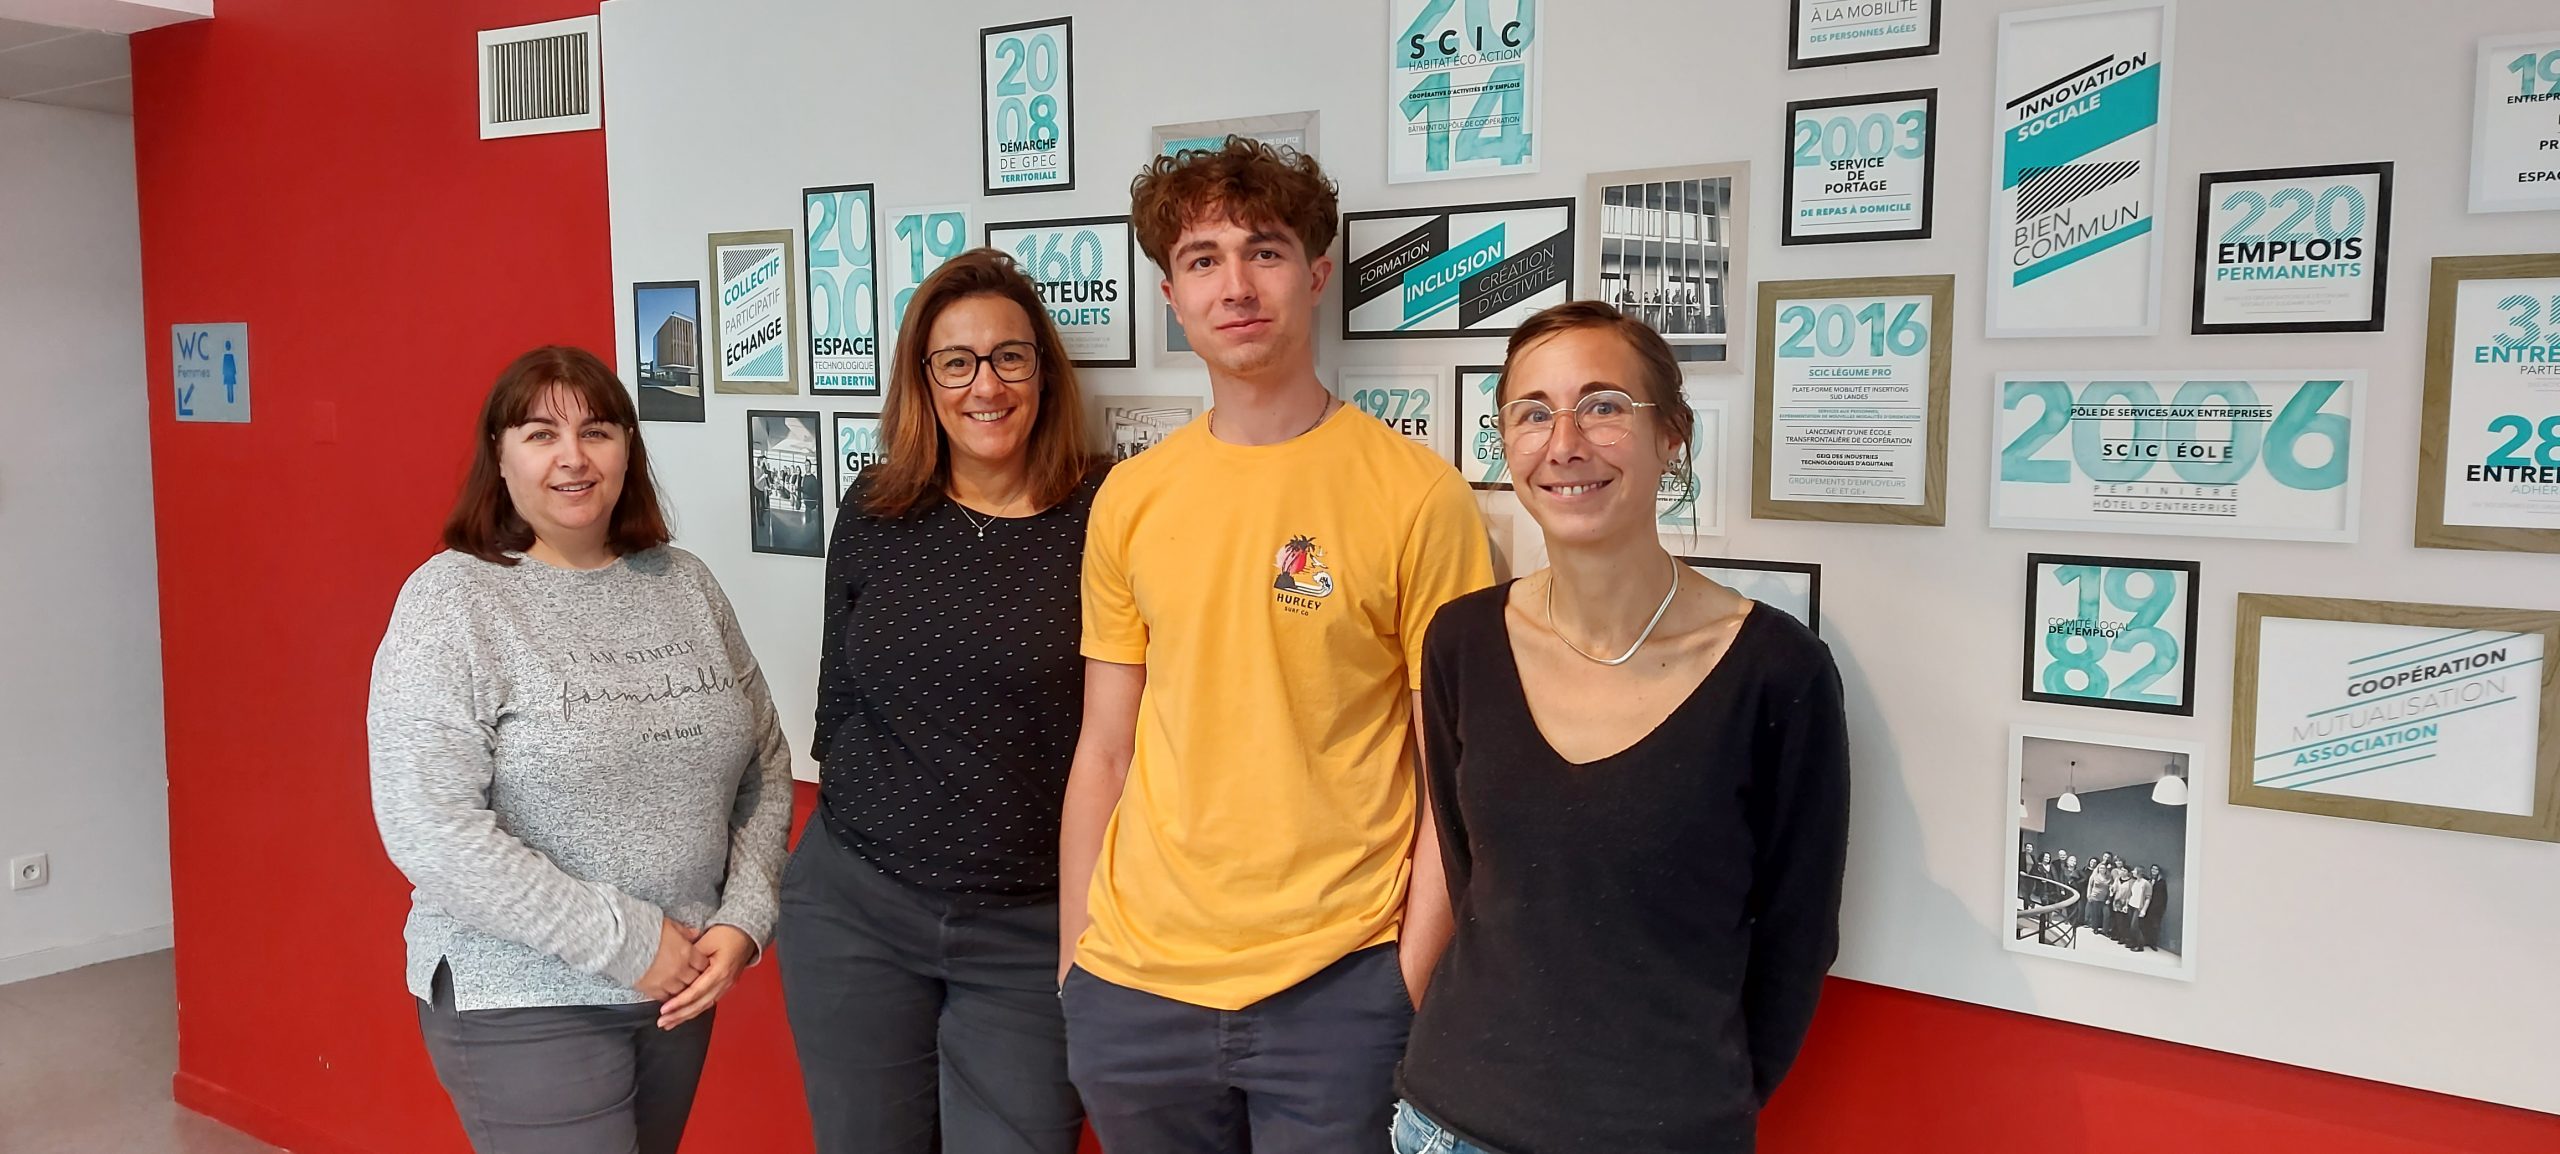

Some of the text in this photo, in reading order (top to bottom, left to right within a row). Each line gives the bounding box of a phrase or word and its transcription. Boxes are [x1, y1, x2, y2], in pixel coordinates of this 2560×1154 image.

[1811, 8, 1822, 23] À
[1826, 6, 1843, 21] LA
[1410, 21, 1521, 59] SCIC
[1810, 24, 1917, 43] DES PERSONNES ÂGÉES
[995, 33, 1059, 97] 20
[1408, 49, 1522, 72] HABITAT ÉCO ACTION
[2019, 51, 2148, 121] INNOVATION
[997, 94, 1059, 152] 08
[1399, 64, 1533, 173] 14
[1408, 123, 1438, 134] BÂTIMENT
[1438, 123, 1448, 131] DU
[1475, 116, 1520, 127] COOPÉRATION
[2017, 94, 2101, 142] SOCIALE
[1000, 138, 1056, 153] DÉMARCHE
[1794, 110, 1927, 167] 2003
[1001, 154, 1056, 170] DE GPEC
[1829, 157, 1885, 171] SERVICE
[1001, 171, 1057, 183] TERRITORIALE
[1825, 180, 1887, 194] PORTAGE
[1847, 171, 1865, 181] DE
[1801, 203, 1912, 217] DE REPAS À DOMICILE
[2219, 185, 2366, 245] 220
[808, 191, 871, 267] 20
[2013, 201, 2139, 267] COMMUN
[2015, 208, 2071, 247] BIEN
[2218, 236, 2363, 264] EMPLOIS
[1360, 241, 1430, 286] FORMATION
[1406, 241, 1502, 303] INCLUSION
[1479, 244, 1555, 292] CRÉATION
[2217, 263, 2361, 281] PERMANENTS
[724, 256, 781, 307] COLLECTIF
[1478, 262, 1555, 314] D'ACTIVITÉ
[725, 287, 781, 335] PARTICIPATIF
[726, 316, 782, 367] ÉCHANGE
[1779, 302, 1928, 358] 2016
[177, 331, 209, 360] WC
[814, 338, 873, 355] ESPACE
[177, 365, 211, 378] Femmes
[814, 361, 874, 370] TECHNOLOGIQUE
[1809, 367, 1892, 377] SCIC LÉGUME PRO
[815, 376, 874, 386] JEAN BERTIN
[1834, 385, 1861, 393] MOBILITÉ
[1353, 389, 1431, 421] 1972
[2070, 406, 2273, 418] PÔLE DE SERVICES AUX ENTREPRISES
[1786, 436, 1850, 444] TRANSFRONTALIÈRE
[1862, 436, 1912, 444] COOPÉRATION
[1869, 428, 1892, 436] ÉCOLE
[2000, 380, 2351, 491] 2006
[2102, 442, 2233, 459] SCIC ÉOLE
[1788, 477, 1846, 486] GROUPEMENTS
[2466, 465, 2560, 483] ENTRE
[2093, 499, 2237, 514] HÔTEL D'ENTREPRISE
[1277, 593, 1321, 611] HURLEY
[2053, 564, 2177, 631] 19
[1284, 606, 1299, 614] SURF
[2048, 617, 2131, 632] COMITÉ LOCAL
[2048, 625, 2119, 639] DE L'EMPLOI
[568, 640, 696, 664] I AM SIMPLY
[2347, 648, 2507, 697] COOPÉRATION
[2292, 676, 2506, 743] MUTUALISATION
[2293, 723, 2439, 767] ASSOCIATION
